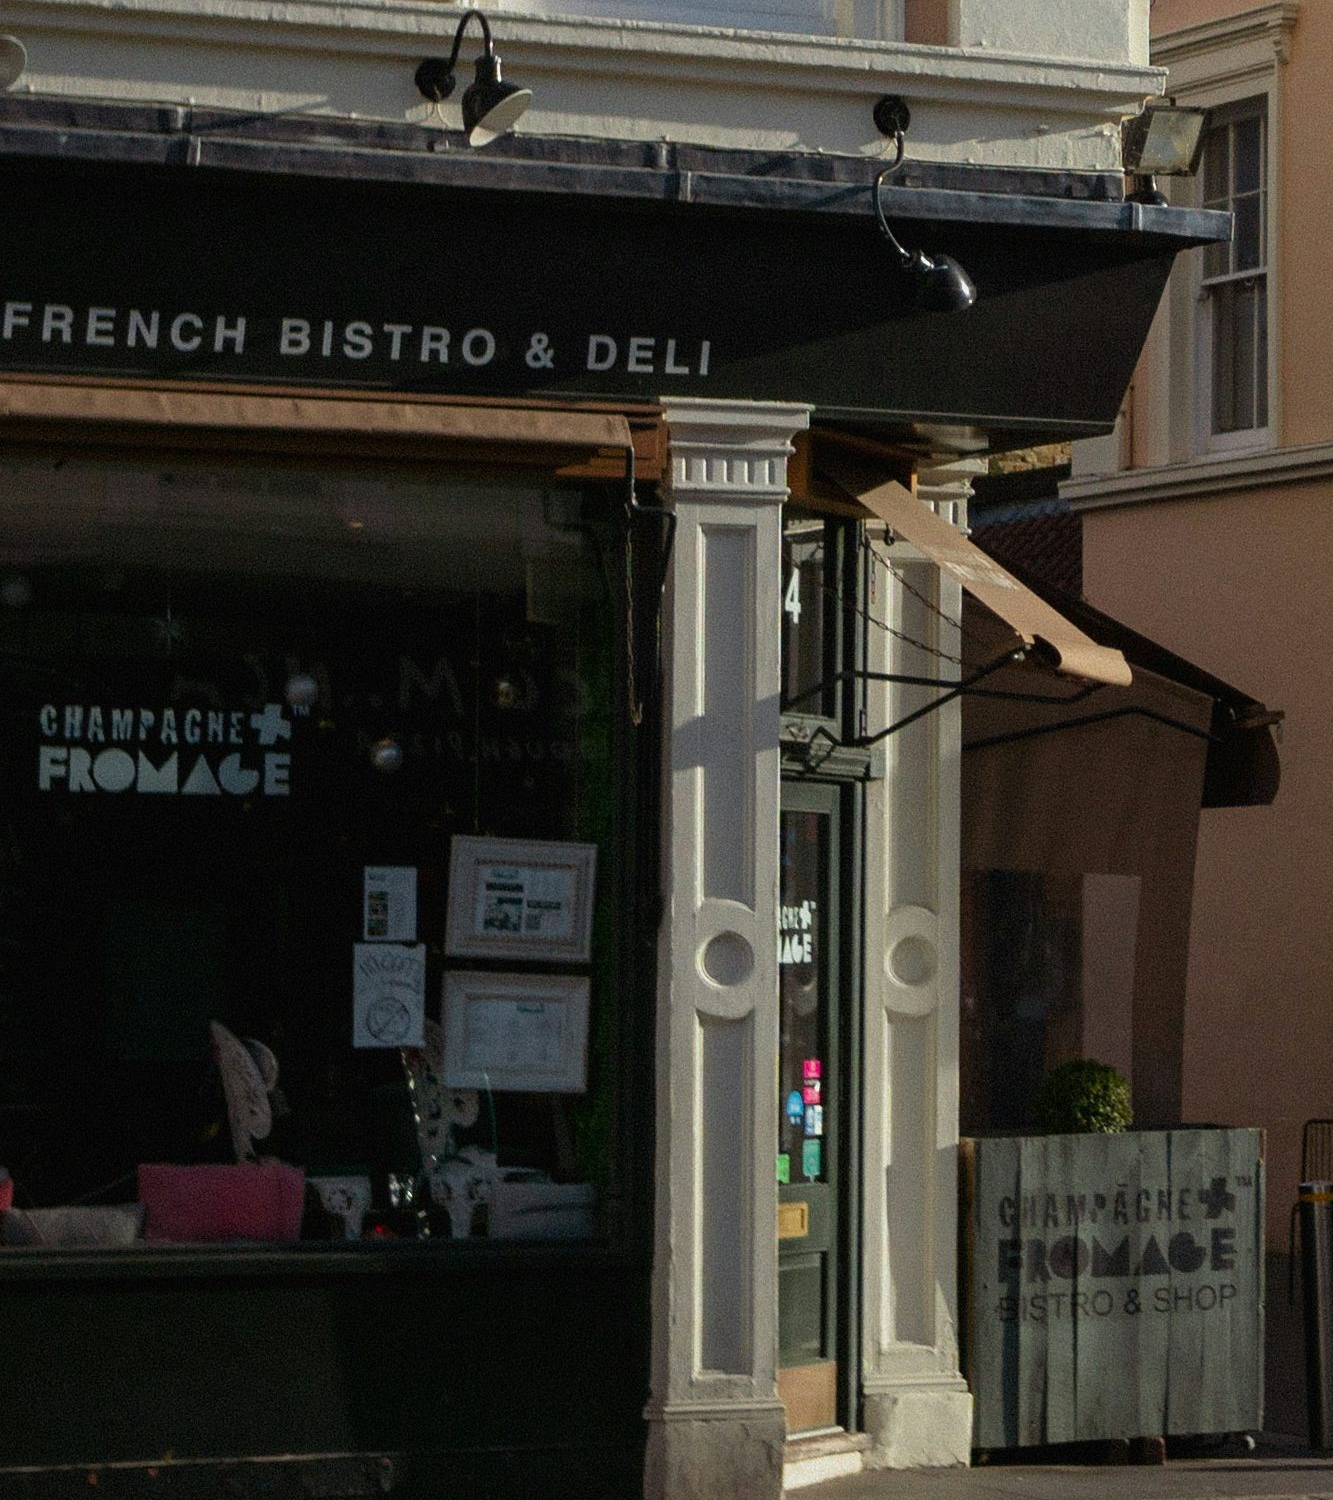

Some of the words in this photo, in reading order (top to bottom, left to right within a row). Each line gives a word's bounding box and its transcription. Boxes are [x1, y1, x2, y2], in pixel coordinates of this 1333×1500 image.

[2, 301, 247, 355] FRENCH
[279, 316, 498, 367] BISTRO
[524, 334, 556, 369] &
[586, 334, 714, 376] DELI
[39, 703, 244, 745] CHAMPAGNE
[38, 745, 291, 796] FROMAGE
[999, 1188, 1192, 1228] CHAMPAGNE
[997, 1226, 1237, 1284] FROMAGE
[998, 1291, 1115, 1322] BISTRO
[1123, 1289, 1143, 1316] &
[1154, 1283, 1238, 1312] SHOP
